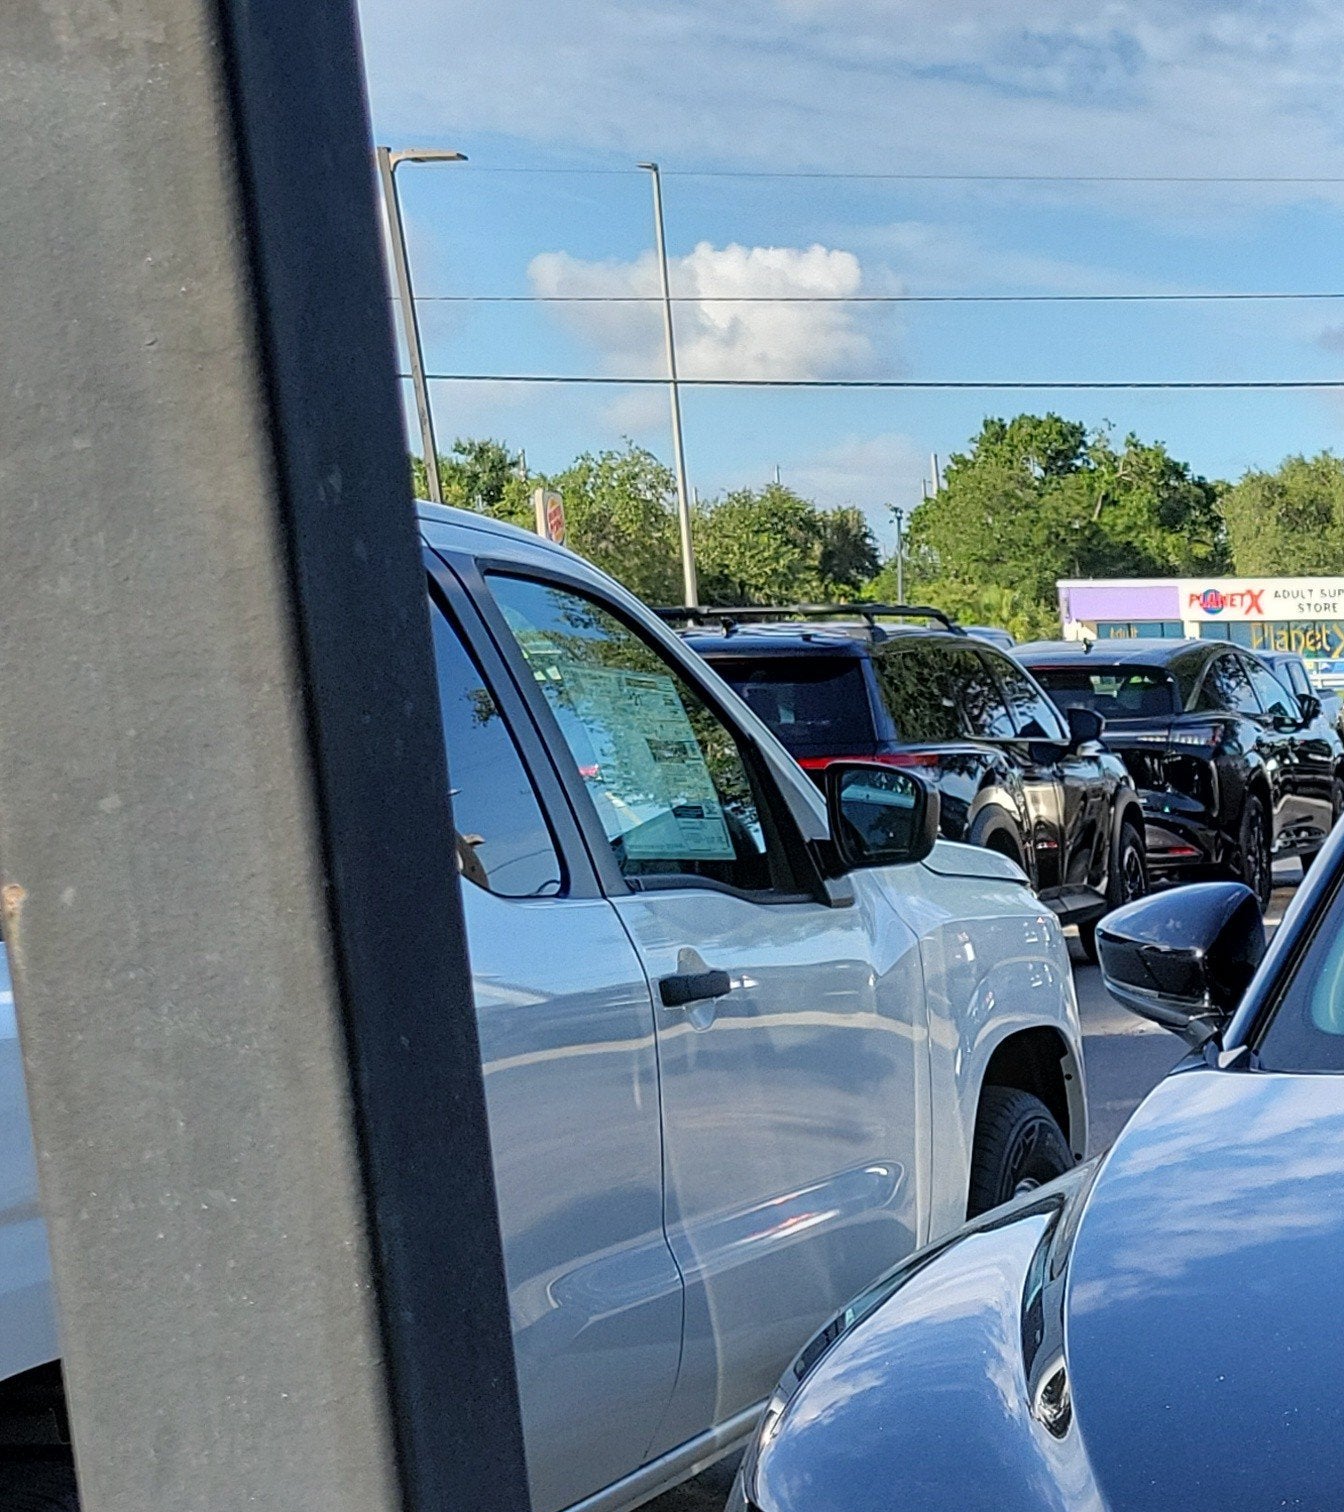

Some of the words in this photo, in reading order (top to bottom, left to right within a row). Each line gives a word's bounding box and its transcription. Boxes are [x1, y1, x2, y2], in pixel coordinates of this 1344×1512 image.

[1188, 592, 1244, 609] PLANET
[1243, 588, 1265, 616] X
[1273, 588, 1314, 600] ADULT
[1297, 601, 1339, 614] STORE
[1251, 621, 1331, 654] Planet
